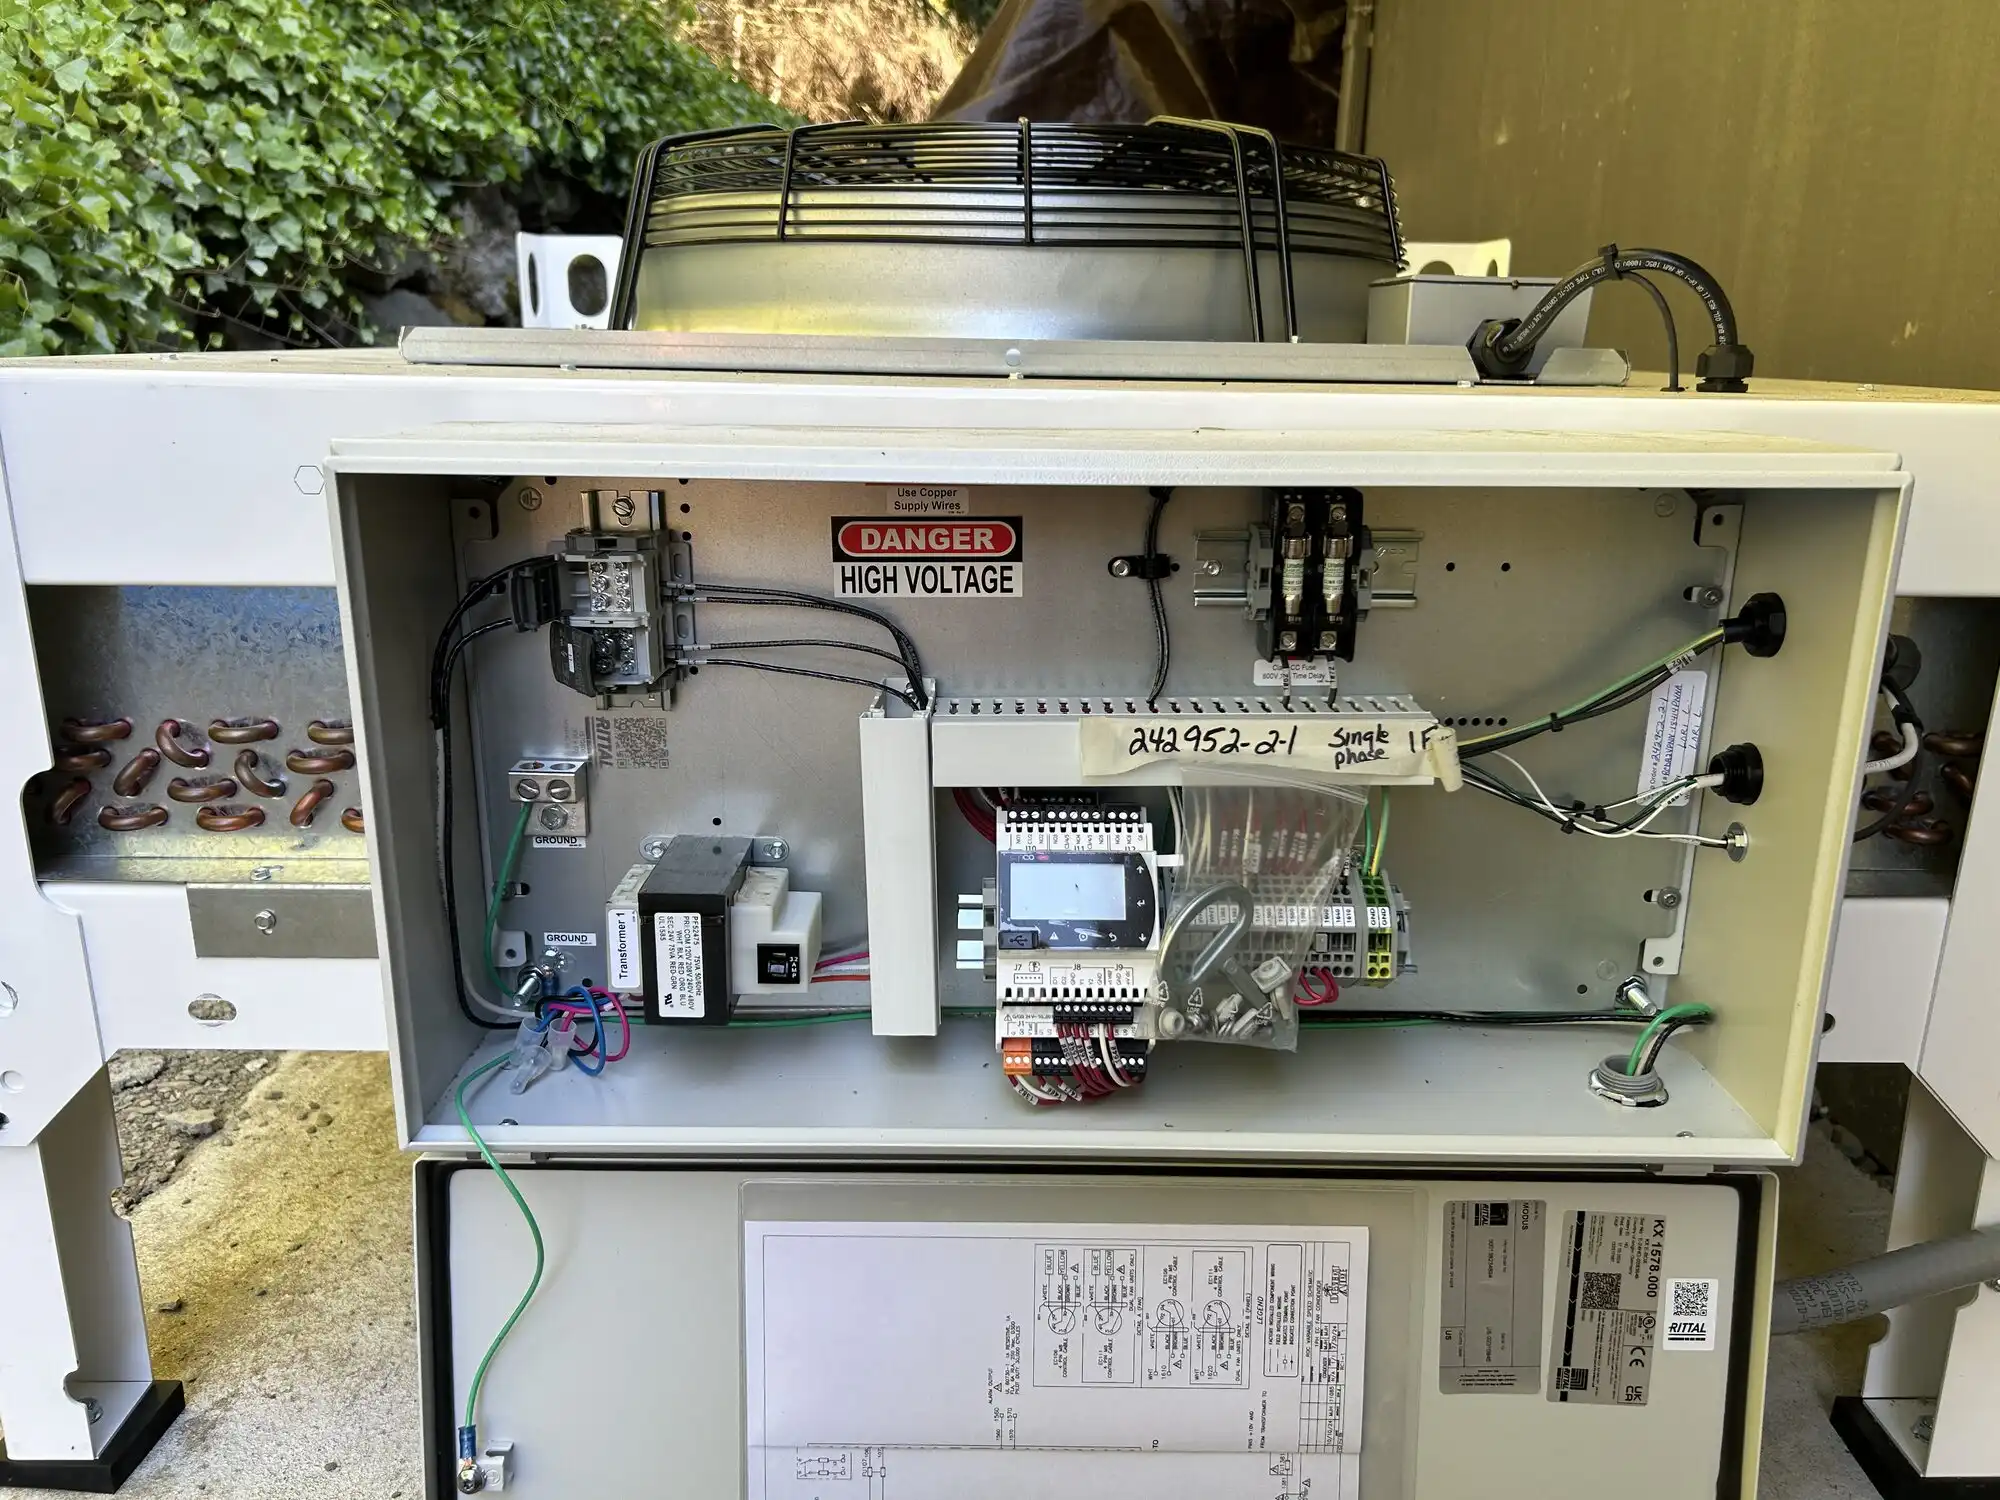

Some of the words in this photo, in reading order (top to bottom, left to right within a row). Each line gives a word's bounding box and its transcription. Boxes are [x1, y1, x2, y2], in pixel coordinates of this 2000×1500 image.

[1575, 273, 1590, 285] TYPE
[897, 488, 912, 497] Use
[919, 487, 957, 500] Copper
[894, 501, 929, 513] Supply
[931, 501, 961, 510] Wires
[861, 528, 996, 551] DANGER
[841, 565, 898, 594] HIGH
[905, 565, 1014, 594] VOLTAGE
[1308, 673, 1326, 681] Delay
[596, 716, 614, 768] RITTAL
[1129, 724, 1298, 756] 242952-2-1
[617, 920, 629, 980] Transformer
[693, 955, 701, 971] 75VA
[1653, 1219, 1665, 1238] KX
[1646, 1241, 1662, 1299] 1578.000
[1256, 1296, 1264, 1325] LEGEND
[1445, 1329, 1452, 1341] US
[1668, 1322, 1707, 1333] RITTAL
[1152, 1440, 1159, 1449] TO
